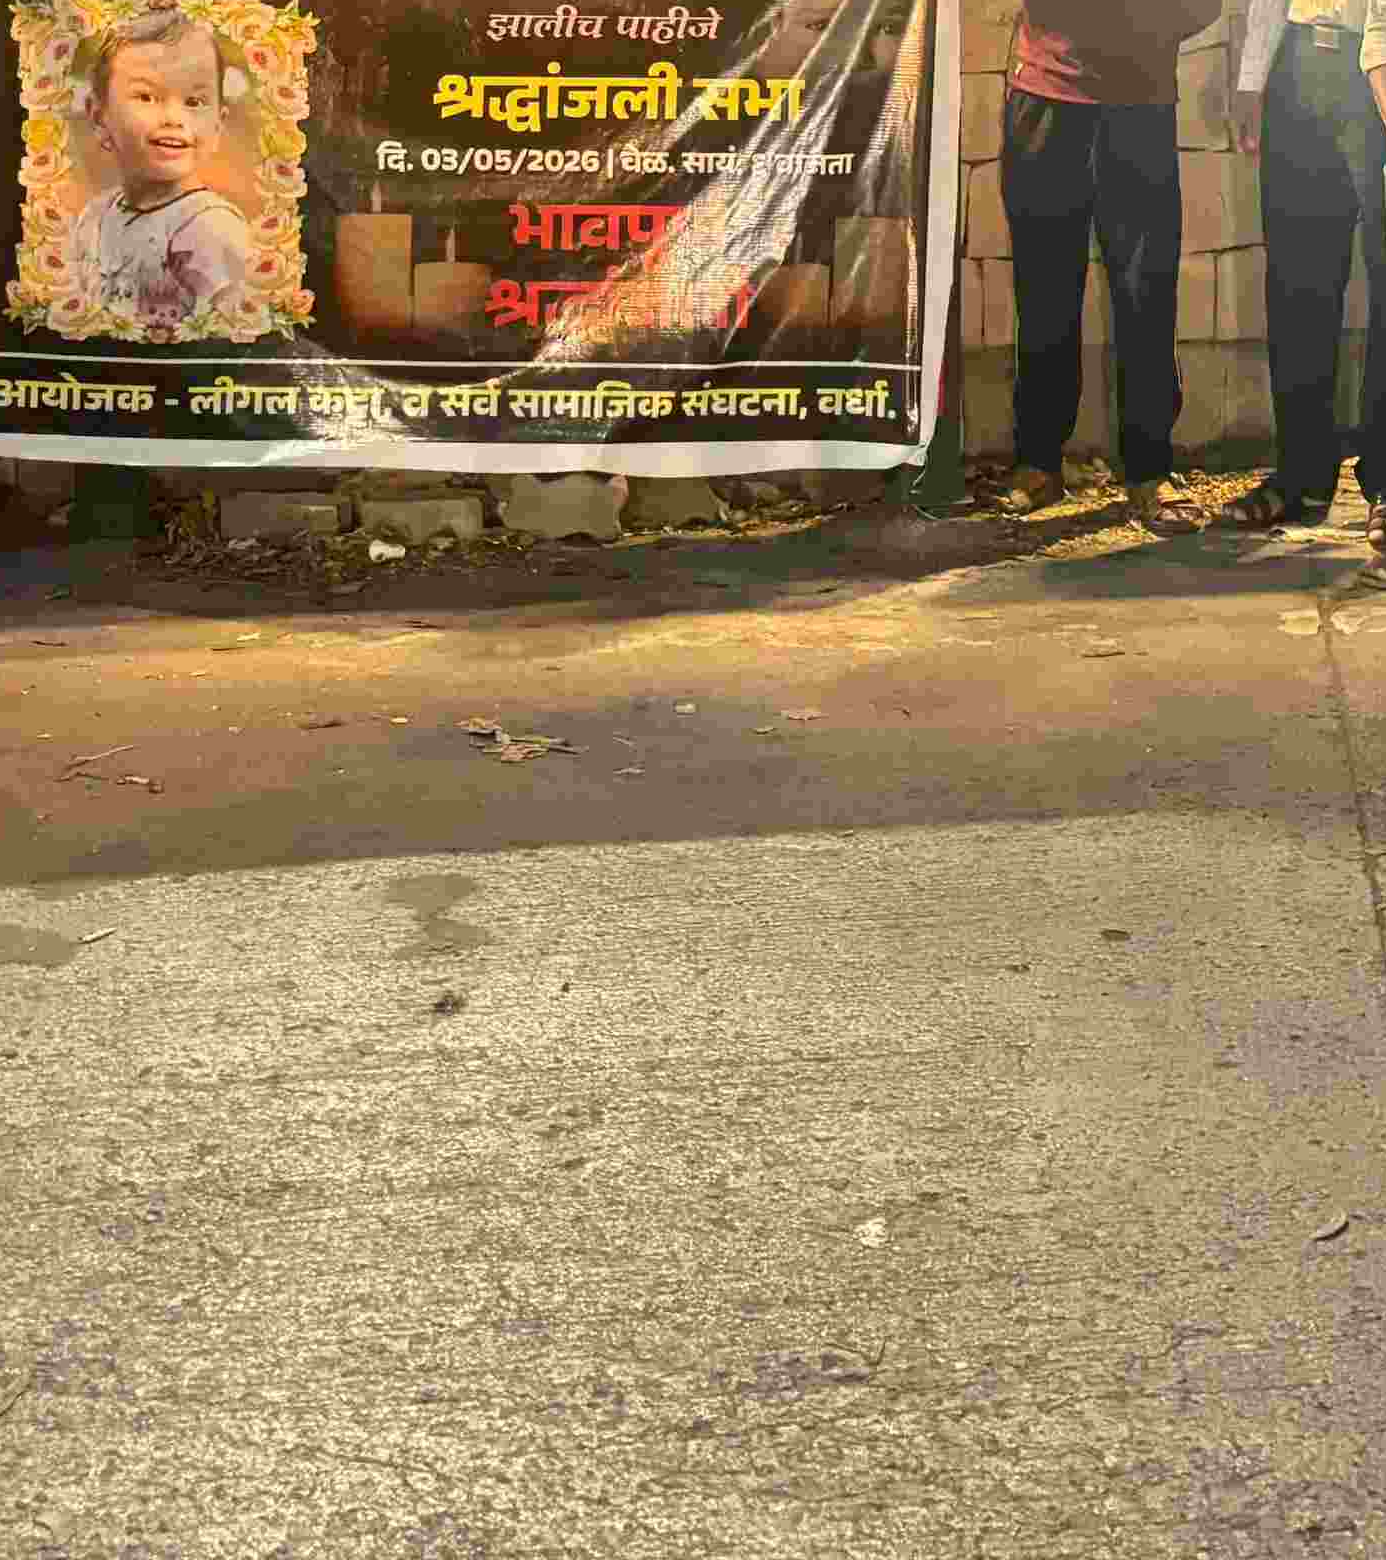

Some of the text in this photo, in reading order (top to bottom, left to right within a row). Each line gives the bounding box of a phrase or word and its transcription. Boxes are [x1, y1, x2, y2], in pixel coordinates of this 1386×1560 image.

[485, 3, 725, 45] झालीच पाहीजे
[432, 60, 807, 133] श्रद्धांजली सभा
[375, 140, 414, 174] दि.
[421, 147, 601, 176] 03/05/2026
[188, 375, 301, 416] लीगल
[508, 380, 676, 419] सामाजिक
